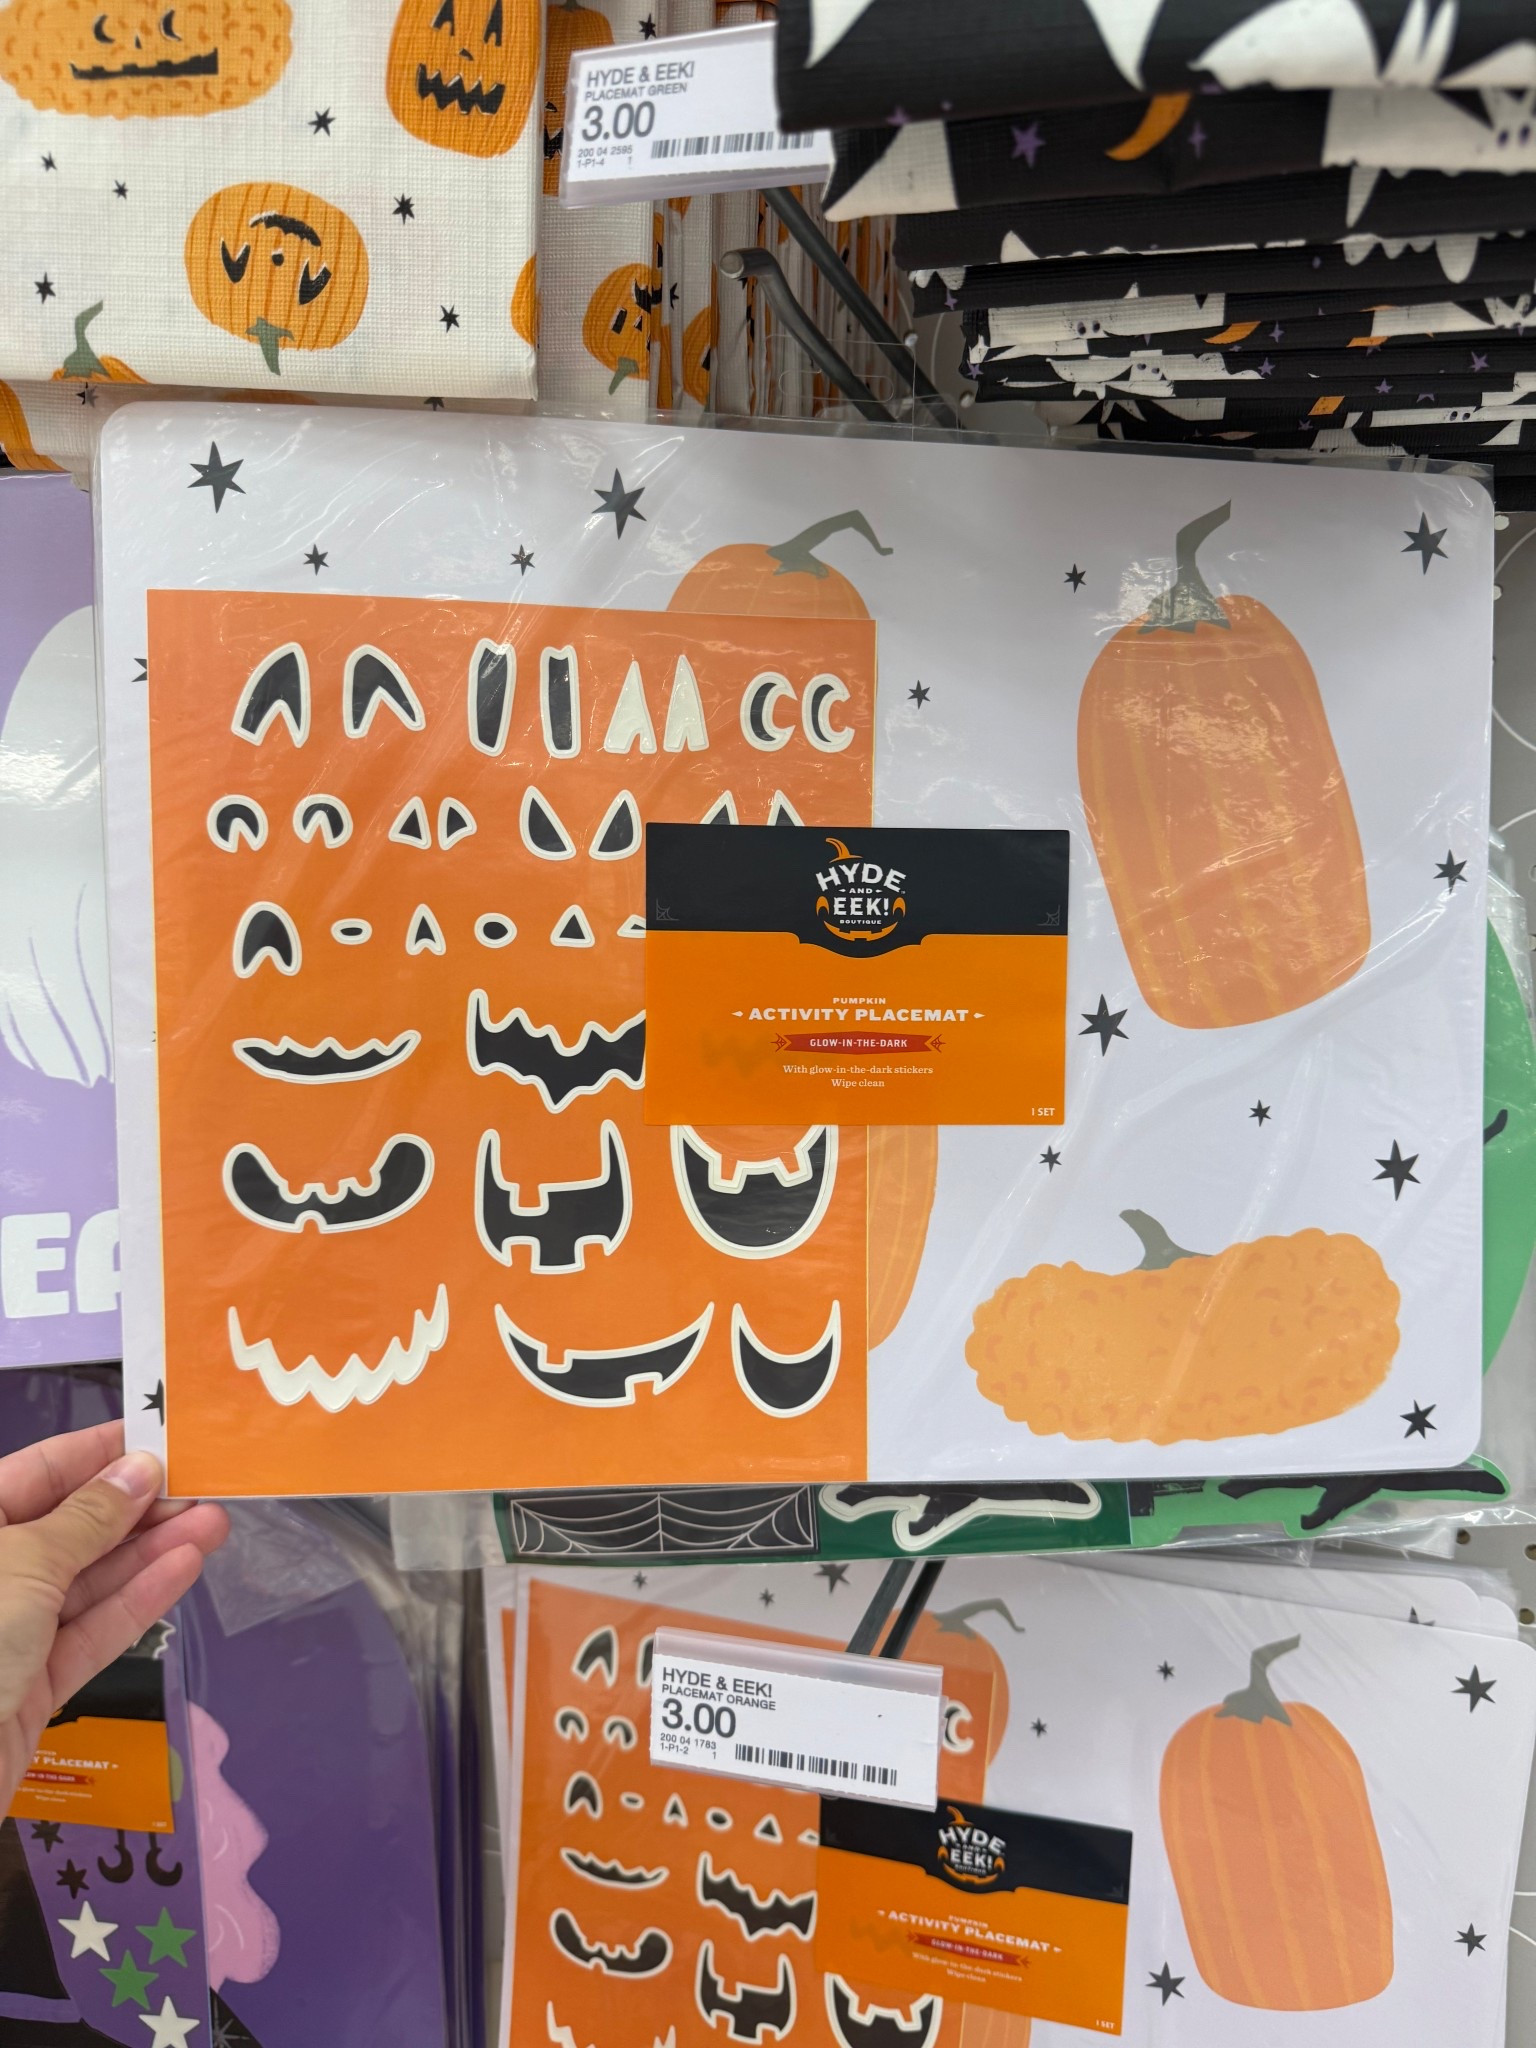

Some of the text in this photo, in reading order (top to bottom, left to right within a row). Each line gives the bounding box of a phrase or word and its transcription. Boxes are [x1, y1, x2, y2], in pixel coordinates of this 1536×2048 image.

[587, 66, 634, 88] HYDE
[639, 66, 650, 83] &
[585, 82, 687, 101] PLACEMAT GREEN
[581, 101, 656, 142] 3.00
[577, 148, 594, 158] 200
[596, 147, 608, 157] 04
[815, 862, 907, 892] HYDE
[833, 897, 889, 917] EEK!
[832, 997, 886, 1005] PUMPKIN
[748, 1007, 969, 1022] ACTIVITY PLACEMAT
[809, 1038, 908, 1048] GLOW-IN-THE-DARK
[783, 1065, 934, 1075] With glow-in-the-dark stickers
[831, 1078, 885, 1088] Wipe clean
[1037, 1107, 1055, 1116] SET
[662, 1667, 772, 1698] HYDE & EEK!
[662, 1684, 776, 1710] PLACEMAT ORANGE
[661, 1698, 736, 1738] 3.00
[660, 1733, 717, 1750] 200 04 1783
[660, 1743, 689, 1755] 1-P1-2
[43, 1756, 110, 1770] PLACEMAT
[938, 1826, 1006, 1856] HYDE
[950, 1848, 993, 1871] EEK!
[888, 1910, 1050, 1953] ACTIVITY PLACEMAT
[1101, 2020, 1115, 2030] SET
